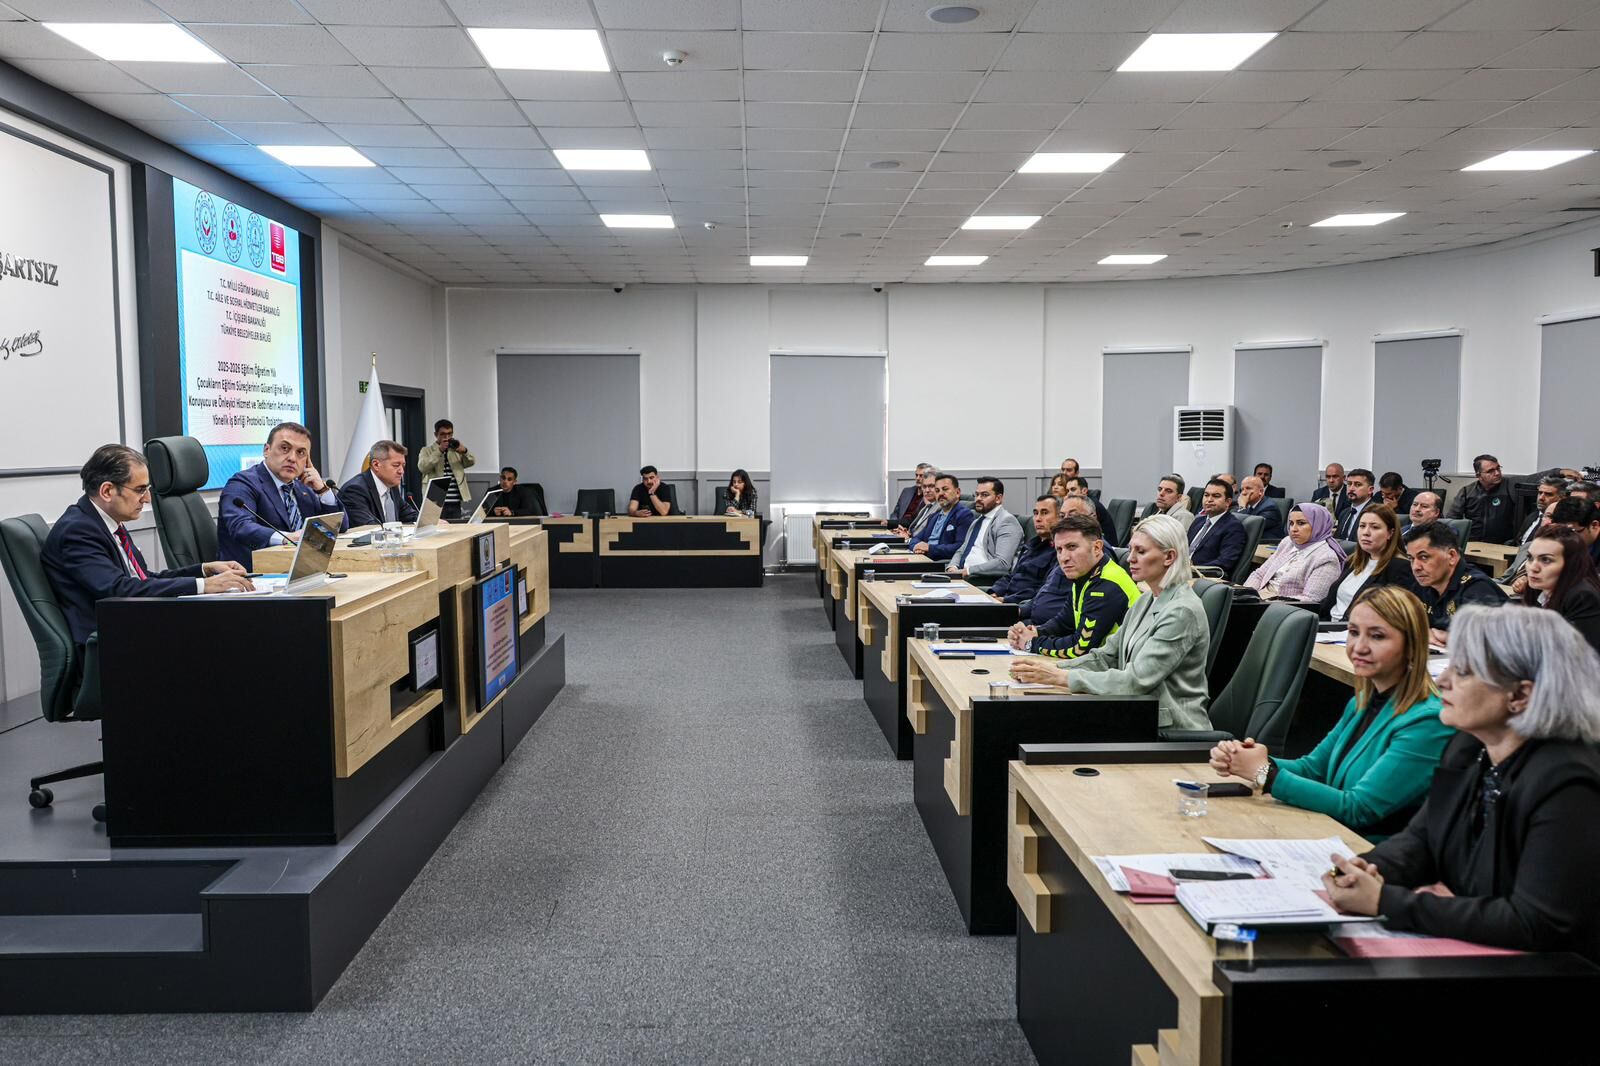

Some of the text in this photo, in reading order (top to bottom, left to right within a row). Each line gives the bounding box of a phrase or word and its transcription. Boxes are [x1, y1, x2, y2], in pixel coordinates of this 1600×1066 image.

[222, 379, 235, 392] Eğitim
[189, 395, 211, 409] Koruyucu
[212, 399, 217, 407] ve
[218, 395, 235, 410] Önleyici
[236, 397, 250, 408] Hizmet
[251, 401, 256, 409] ve
[213, 415, 229, 426] Yönelik
[247, 416, 265, 426] Protokolü
